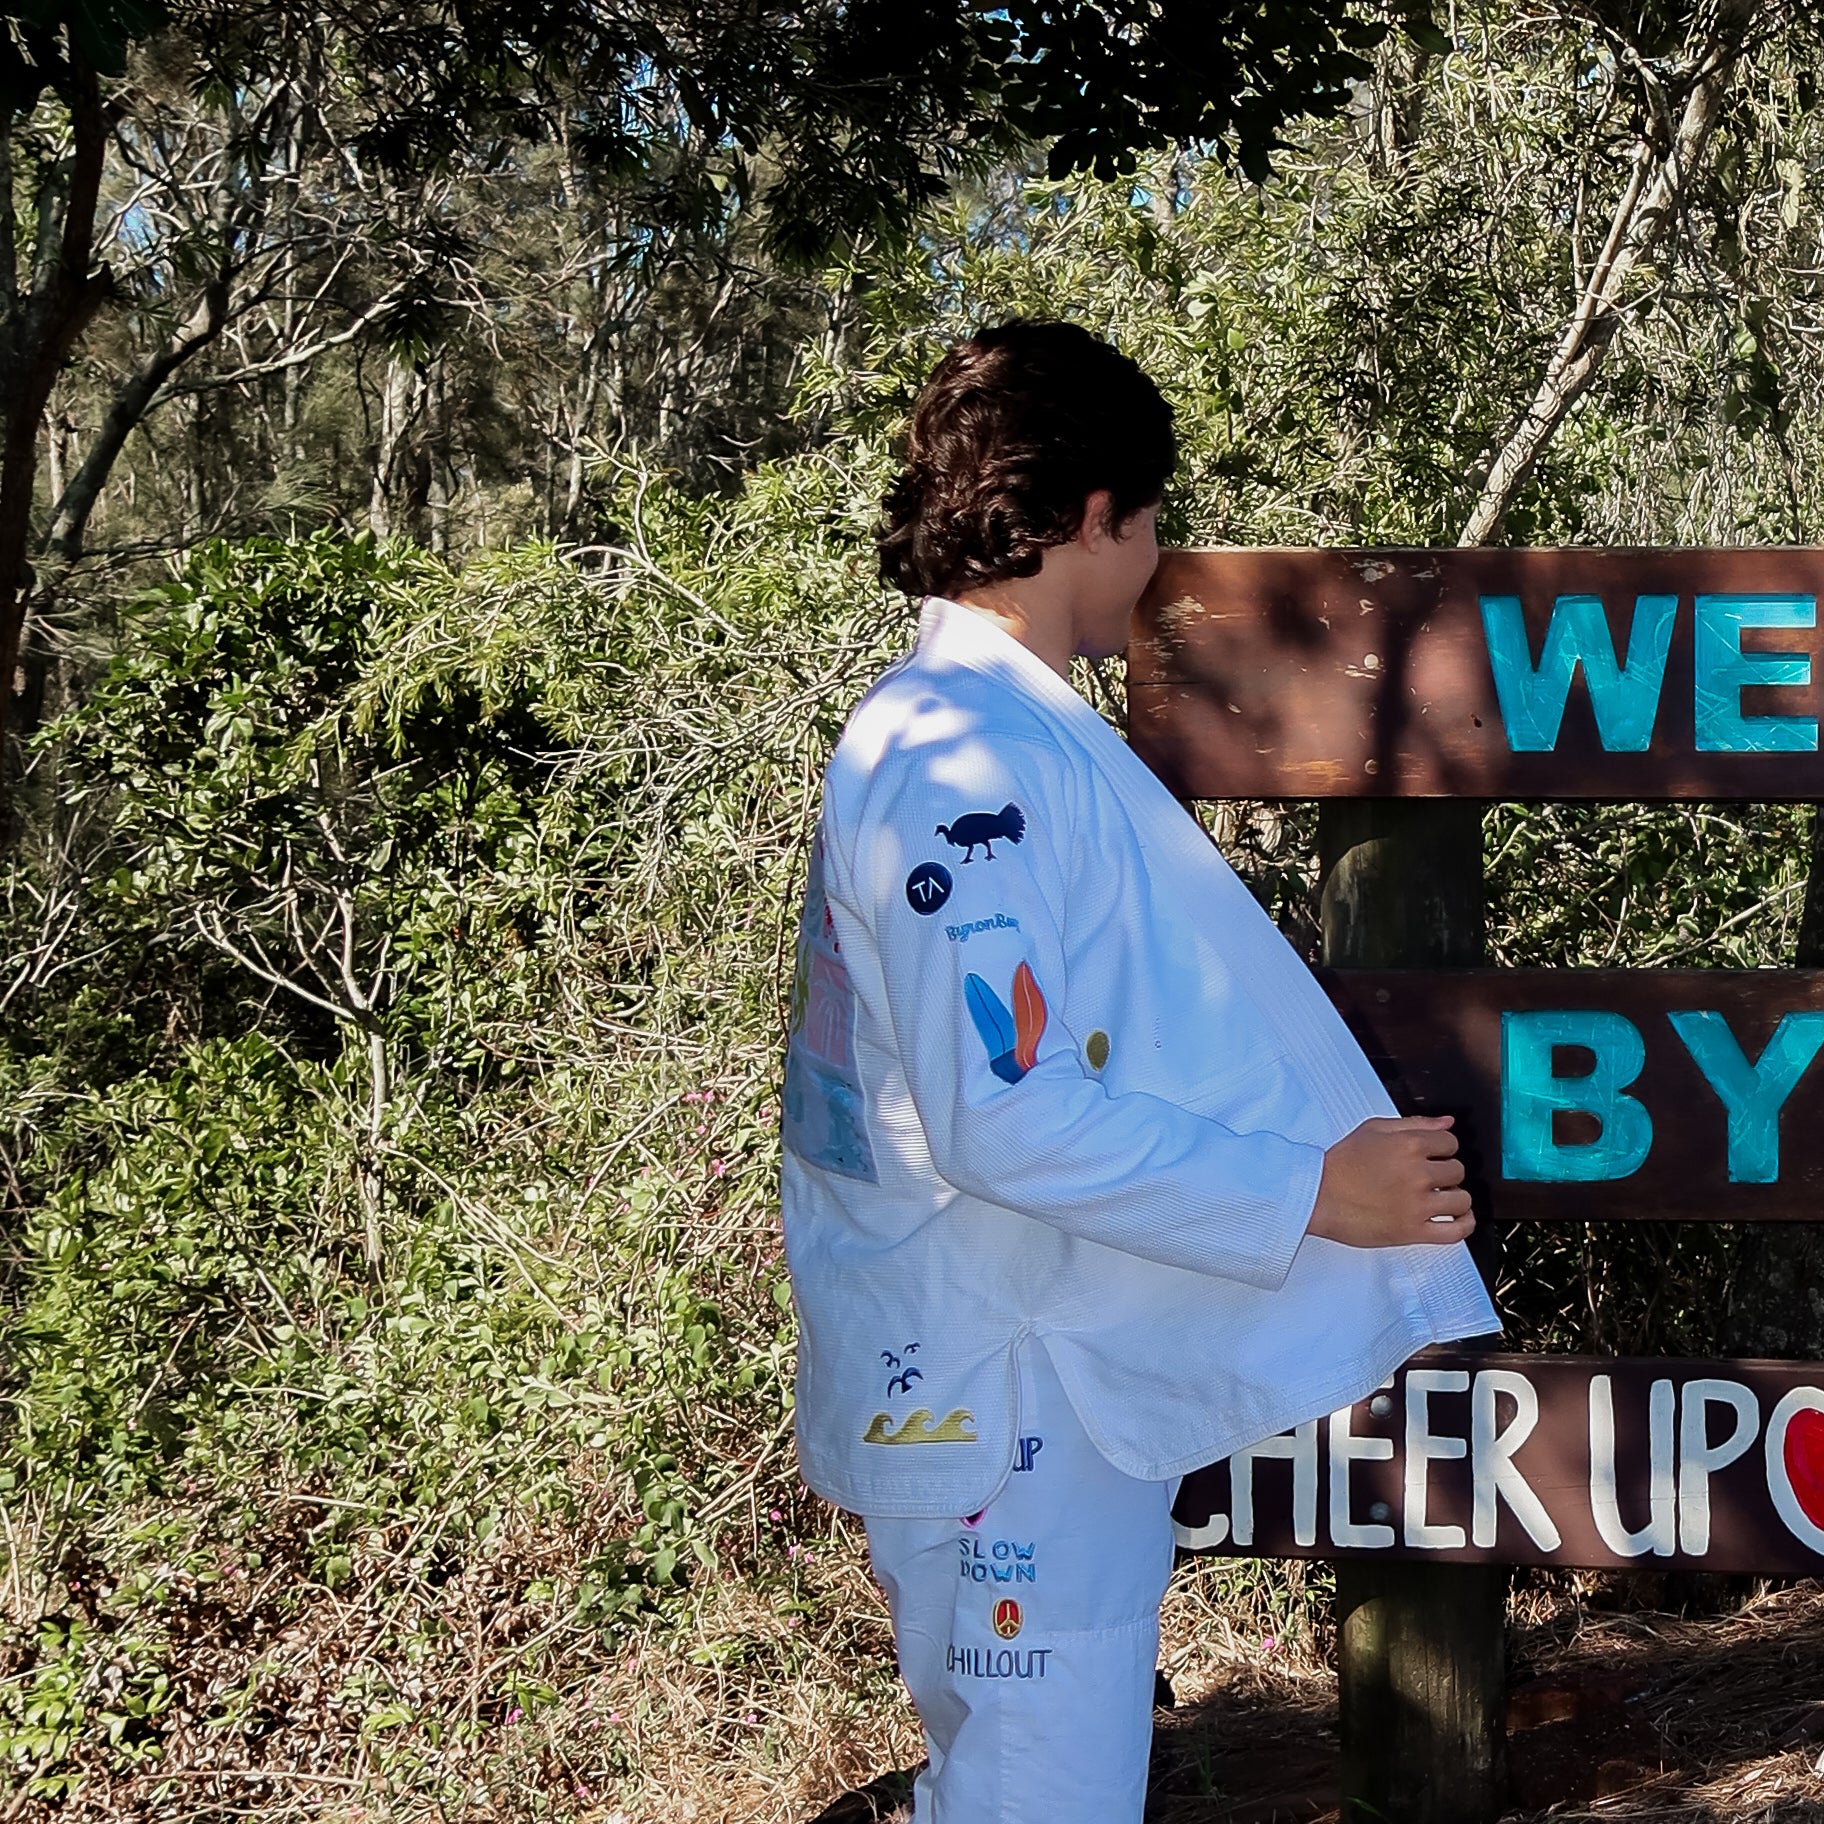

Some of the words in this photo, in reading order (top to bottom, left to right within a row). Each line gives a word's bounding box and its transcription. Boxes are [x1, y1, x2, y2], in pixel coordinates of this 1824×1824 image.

[1588, 1373, 1760, 1558] UP
[958, 1537, 1037, 1561] SLOW
[960, 1559, 1037, 1583] DOWN
